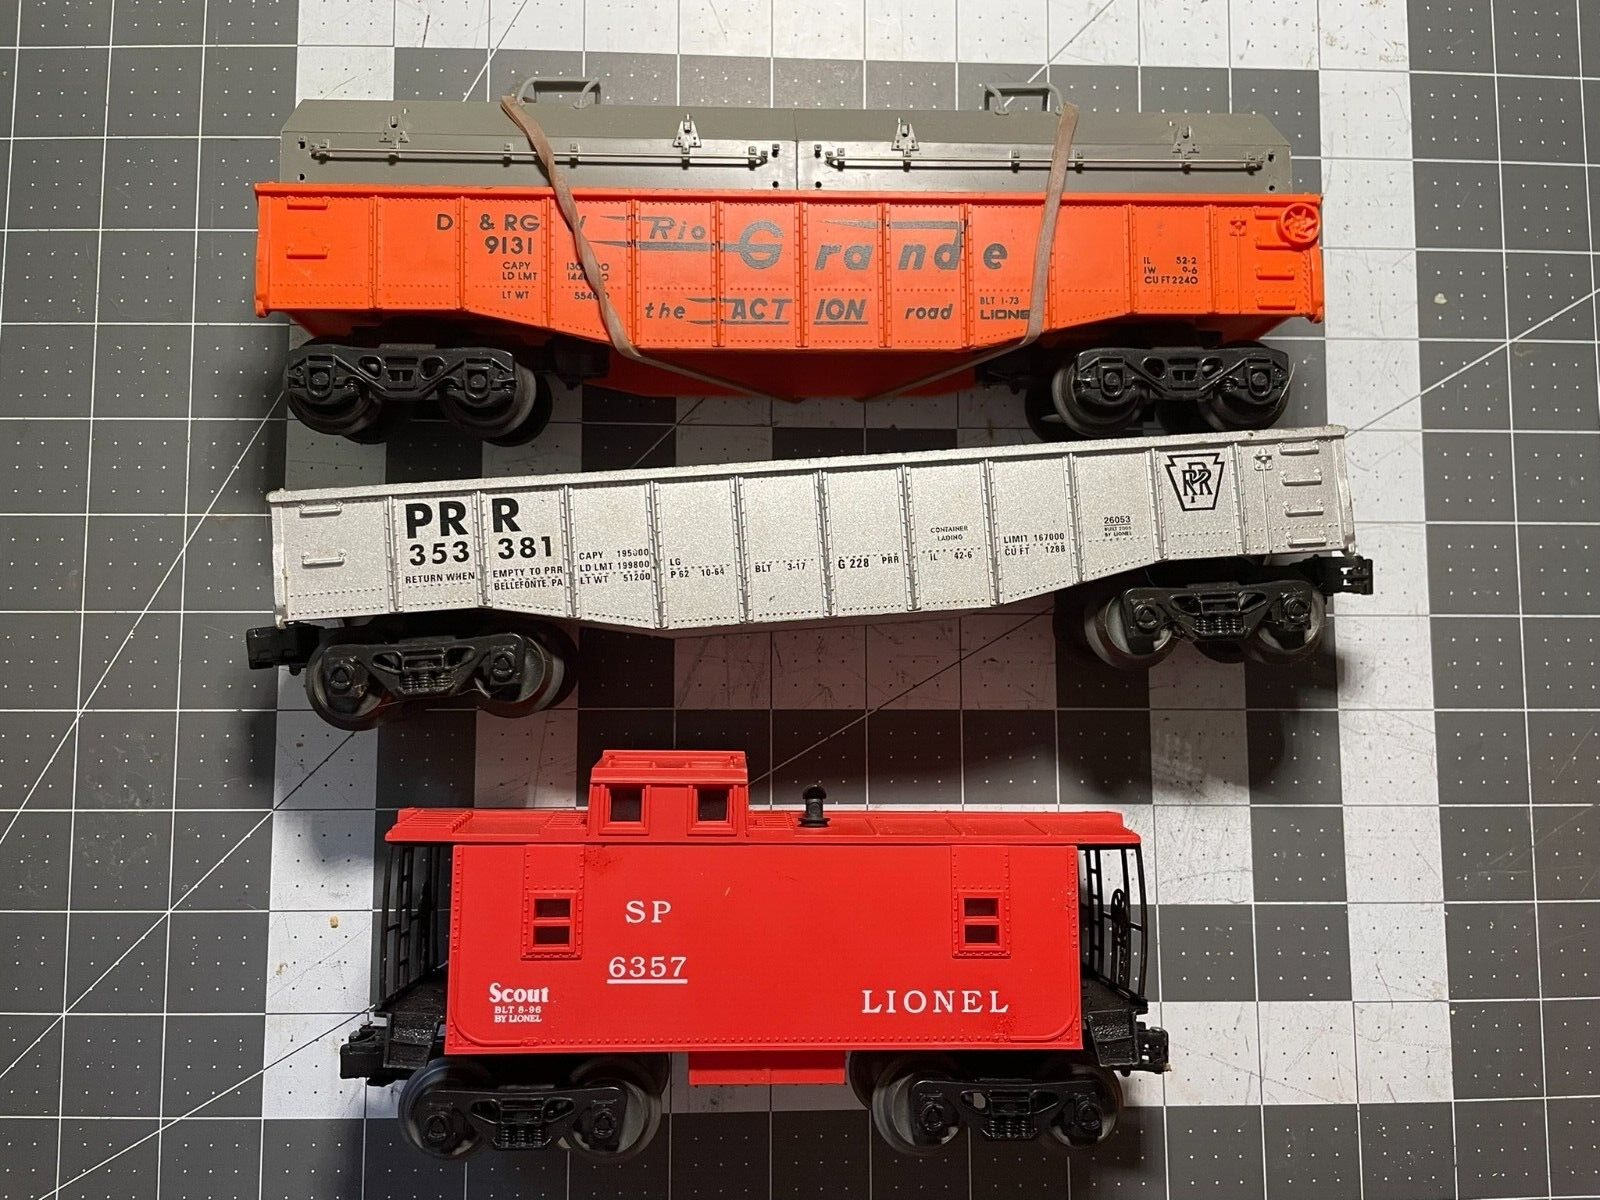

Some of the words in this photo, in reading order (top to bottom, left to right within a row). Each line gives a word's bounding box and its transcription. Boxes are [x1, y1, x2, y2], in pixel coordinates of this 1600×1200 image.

[436, 213, 454, 231] D
[479, 213, 496, 231] &
[649, 216, 707, 240] Rio
[484, 236, 533, 255] 9131
[502, 261, 531, 270] CAPY
[1143, 256, 1151, 265] IL
[1176, 256, 1197, 265] 52-2
[1144, 266, 1157, 274] IW
[502, 272, 516, 281] LD
[518, 272, 538, 281] LMT
[1144, 276, 1159, 284] CU
[1161, 275, 1170, 284] FT
[1171, 276, 1199, 285] 2240
[502, 291, 514, 300] LT
[515, 291, 530, 300] WT
[980, 297, 996, 305] BLT
[645, 303, 686, 319] the
[905, 304, 953, 320] road
[980, 309, 1031, 320] LIONE
[1103, 515, 1131, 525] 26053
[930, 525, 969, 534] CONTAINER
[1003, 534, 1028, 544] LIMIT
[1033, 532, 1065, 541] 167000
[1004, 547, 1017, 556] CU
[1019, 546, 1030, 555] FT
[1045, 544, 1066, 554] 1288
[579, 551, 604, 561] CAPY
[930, 553, 939, 562] IL
[954, 551, 973, 560] 42-6
[580, 564, 592, 573] LD
[594, 563, 613, 572] LMT
[617, 560, 650, 570] 199800
[669, 558, 681, 567] LG
[755, 564, 772, 573] BLT
[787, 562, 807, 571] 3-17
[838, 559, 846, 570] G
[849, 558, 870, 569] 228
[881, 555, 900, 565] PRR
[405, 573, 443, 584] RETURN
[446, 571, 475, 581] WHEN
[493, 568, 525, 578] EMPTY
[530, 567, 541, 576] TO
[544, 566, 563, 575] PRR
[670, 571, 677, 579] P
[679, 569, 690, 578] 62
[701, 568, 725, 577] 10-64
[551, 578, 563, 587] PA
[580, 576, 591, 585] LT
[594, 575, 609, 584] WT
[623, 572, 651, 582] 51200
[625, 899, 672, 924] SP
[608, 955, 687, 979] 6357
[488, 982, 549, 1004] Scout
[861, 989, 1009, 1014] LIONEL
[494, 1005, 515, 1014] BLT
[518, 1005, 542, 1014] 8-96
[494, 1014, 508, 1024] BY
[508, 1014, 543, 1023] LIONEL
